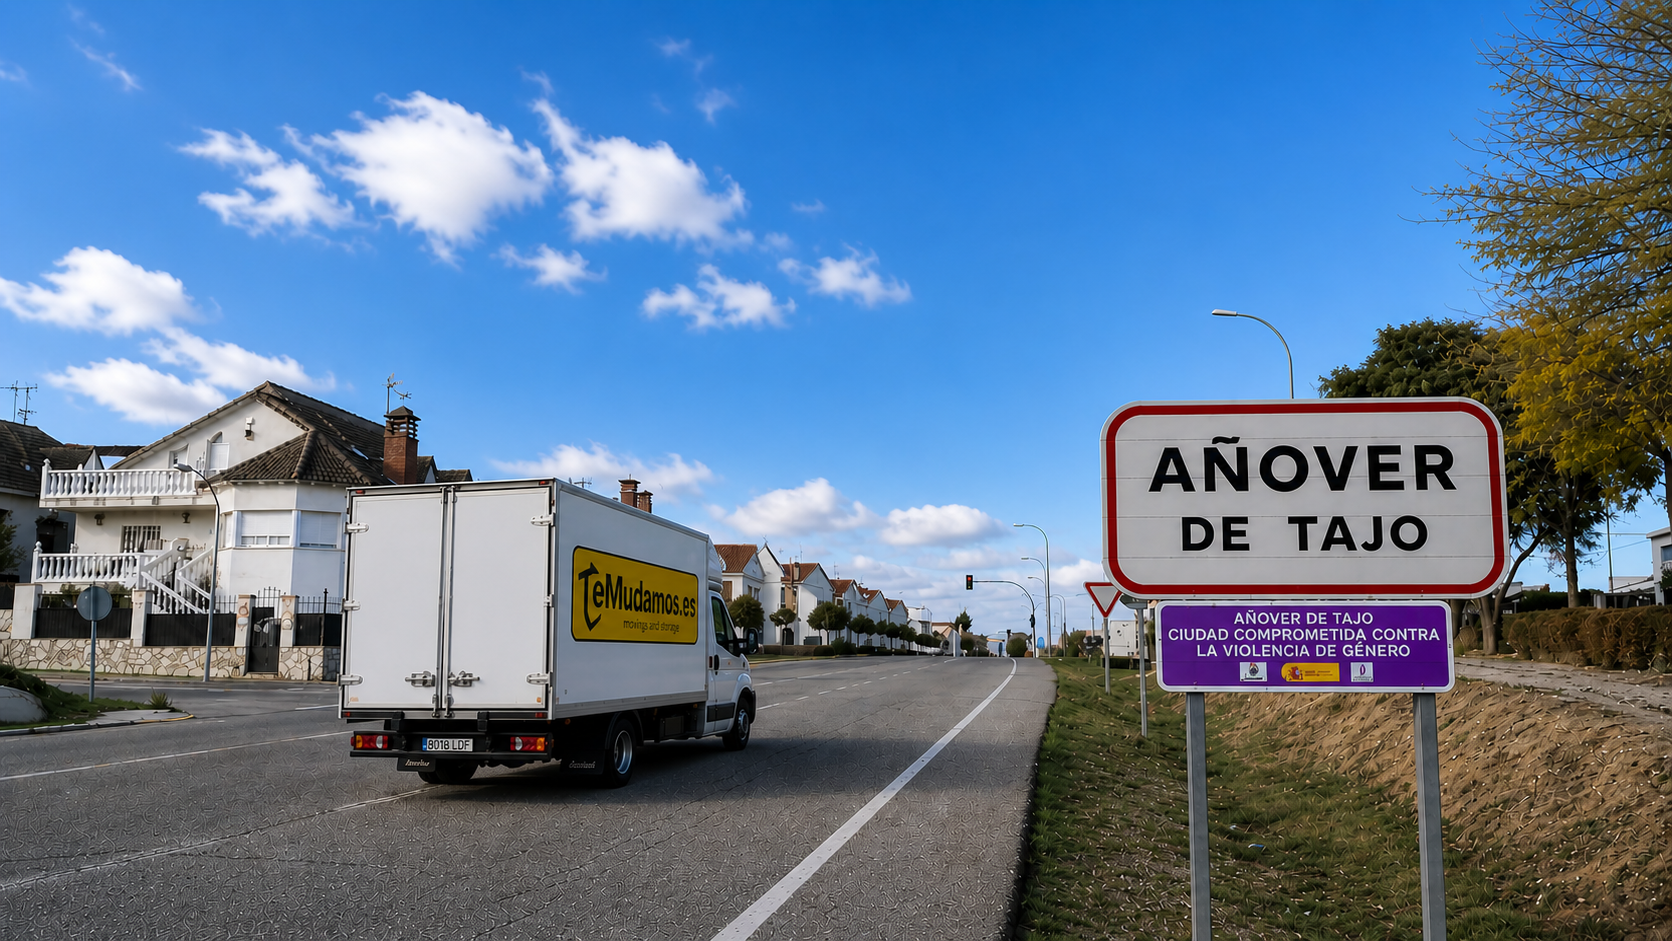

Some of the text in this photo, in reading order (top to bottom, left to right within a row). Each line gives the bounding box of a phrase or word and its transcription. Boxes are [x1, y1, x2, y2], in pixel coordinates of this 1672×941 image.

[1148, 435, 1457, 492] AÑOVER
[1181, 515, 1428, 551] DE TAJO
[578, 562, 696, 632] TeMudamos.es
[1234, 610, 1373, 625] AÑOVER DE TAJO
[649, 621, 659, 631] and
[1168, 628, 1440, 641] CIUDAD COMPROMETIDA CONTRA
[1197, 641, 1411, 657] LA VIOLENCIA DE GÉNERO
[427, 739, 470, 750] 8018 LDF
